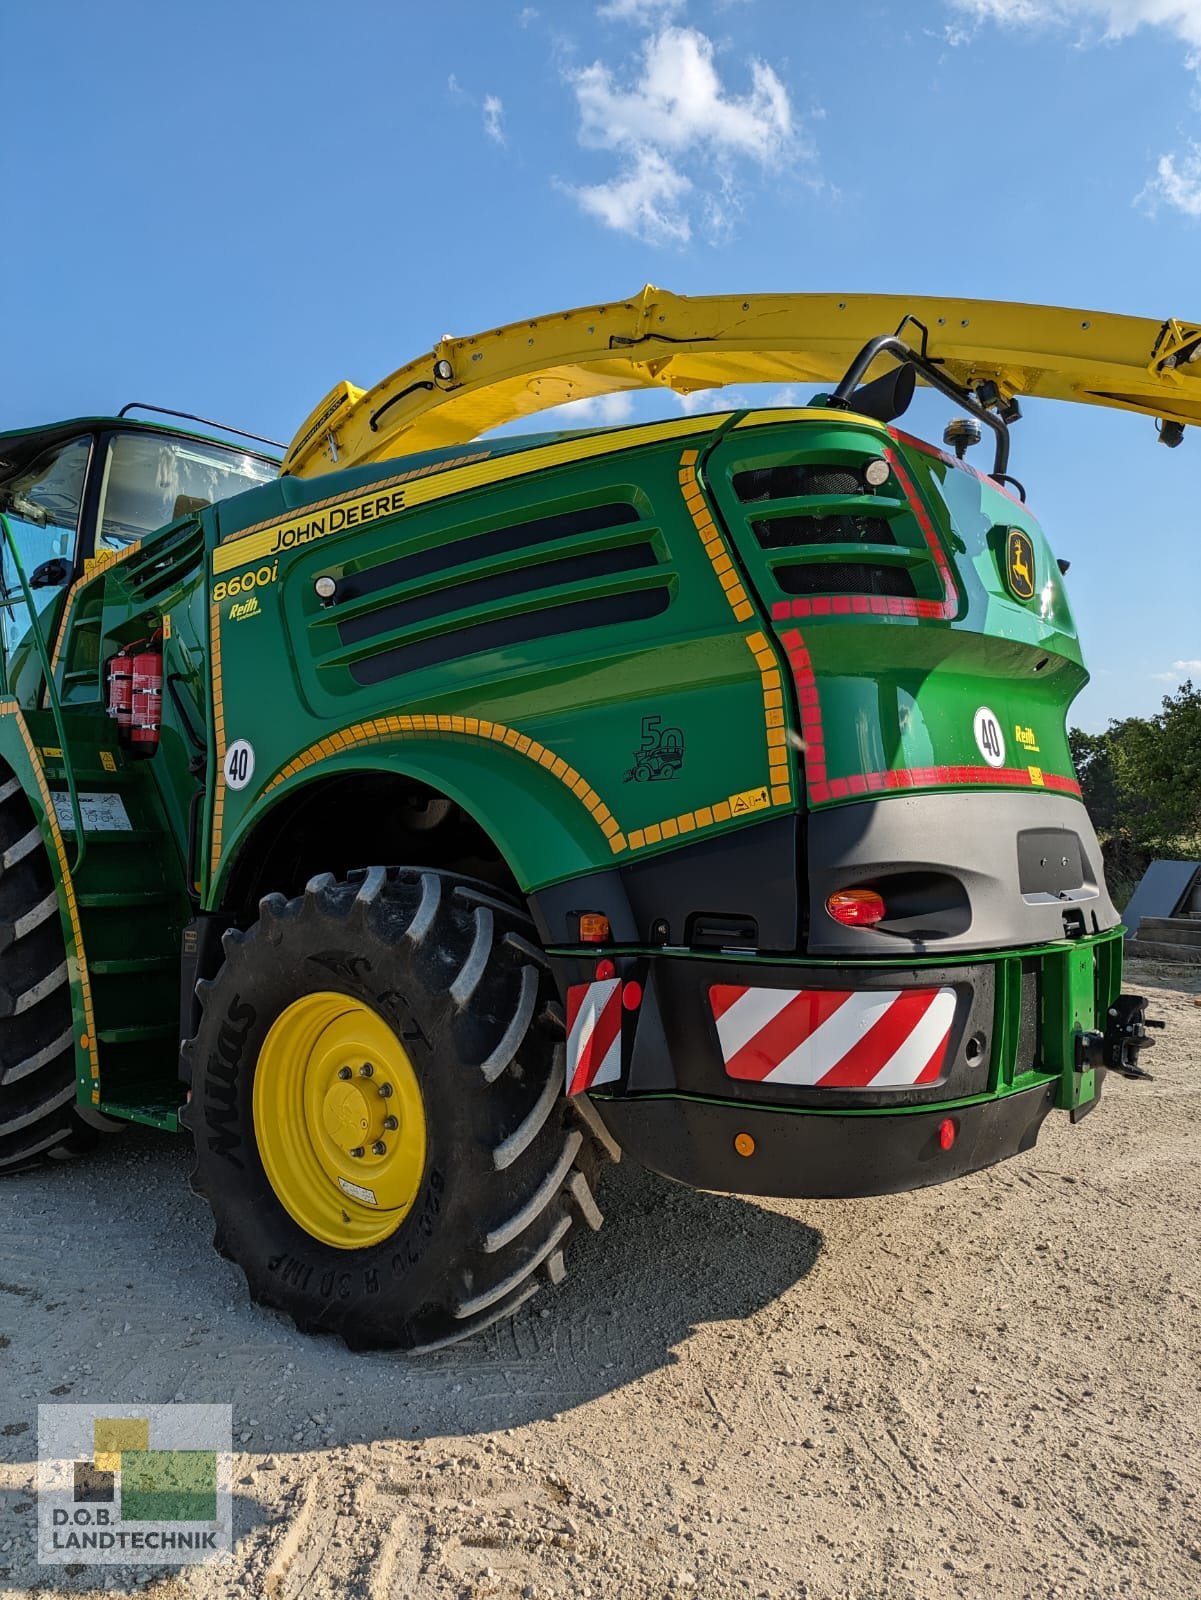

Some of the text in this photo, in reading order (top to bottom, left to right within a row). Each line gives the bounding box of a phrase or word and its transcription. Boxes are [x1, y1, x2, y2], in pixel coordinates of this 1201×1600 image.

[271, 490, 406, 552] JOHN DEERE
[213, 559, 279, 602] 8600i
[981, 718, 1001, 757] 40
[229, 749, 248, 781] 40
